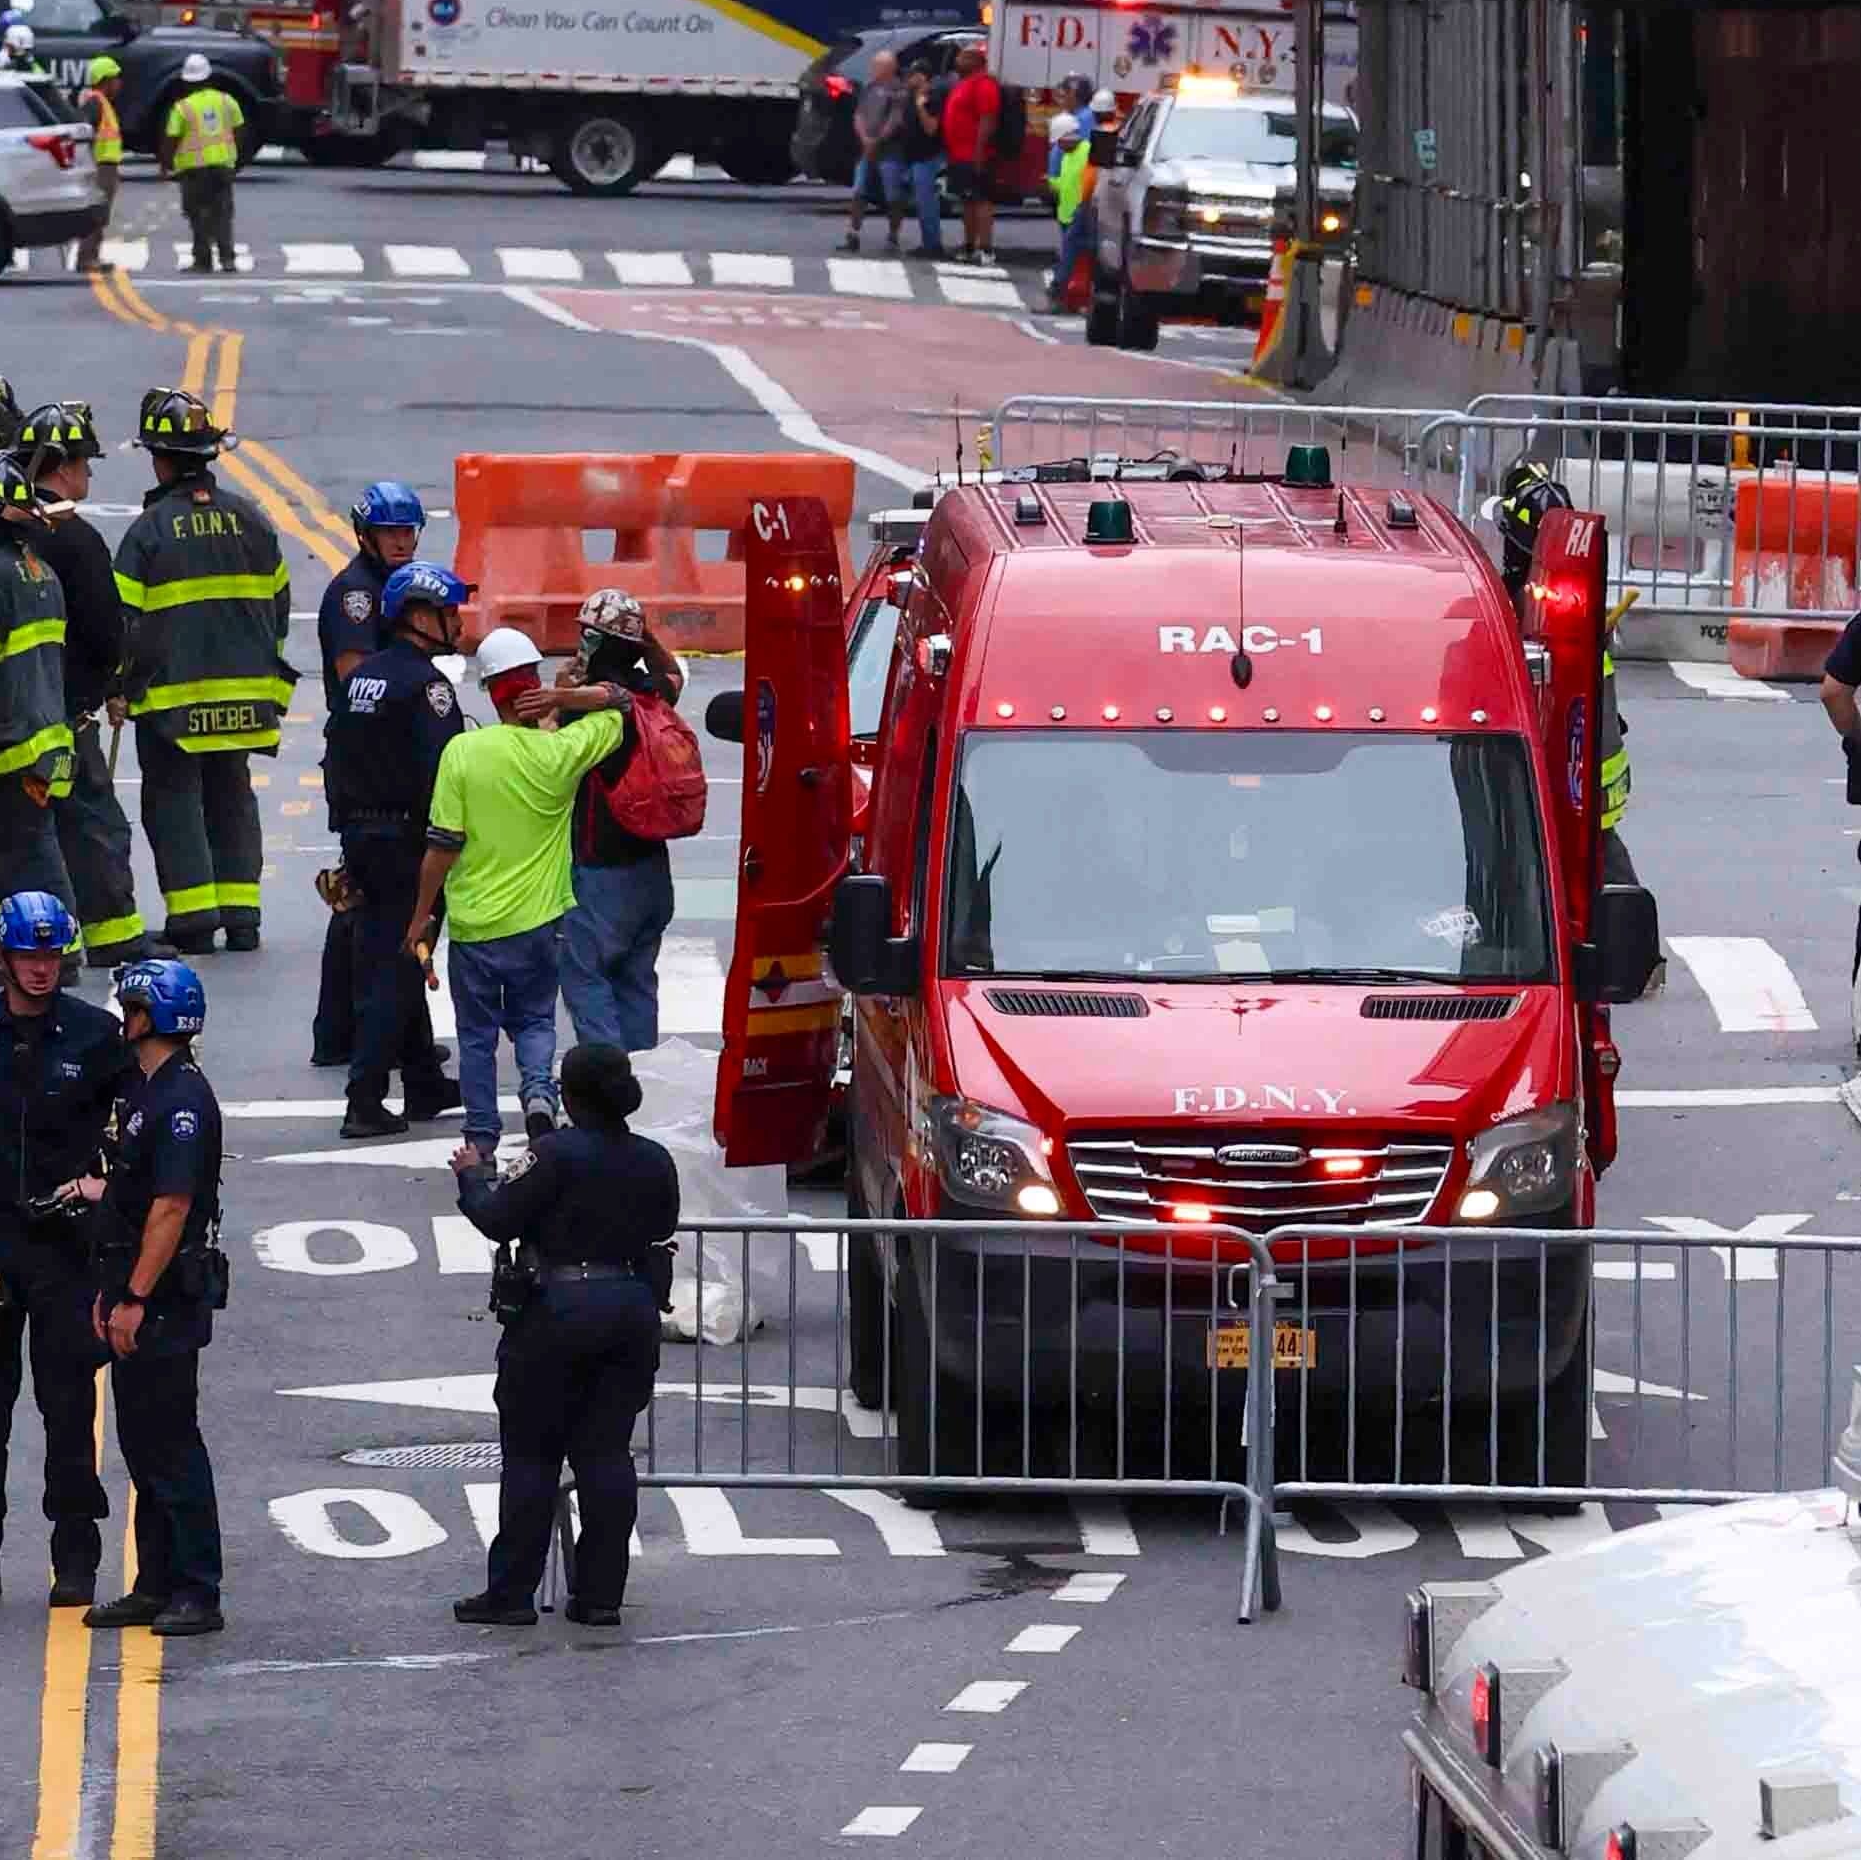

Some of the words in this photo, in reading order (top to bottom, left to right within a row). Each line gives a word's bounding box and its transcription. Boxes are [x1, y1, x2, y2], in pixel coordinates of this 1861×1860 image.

[484, 7, 540, 29] Clean
[544, 10, 576, 30] You
[582, 11, 620, 31] Can
[625, 12, 681, 33] Count
[686, 14, 716, 33] On
[1020, 15, 1093, 49] F.D.
[1565, 519, 1595, 558] RA
[412, 572, 449, 597] NYPD
[1158, 625, 1323, 655] RAC-1
[347, 677, 388, 702] NYPD
[188, 705, 263, 733] STIEBEL
[1173, 1084, 1358, 1117] F.D.N.Y.
